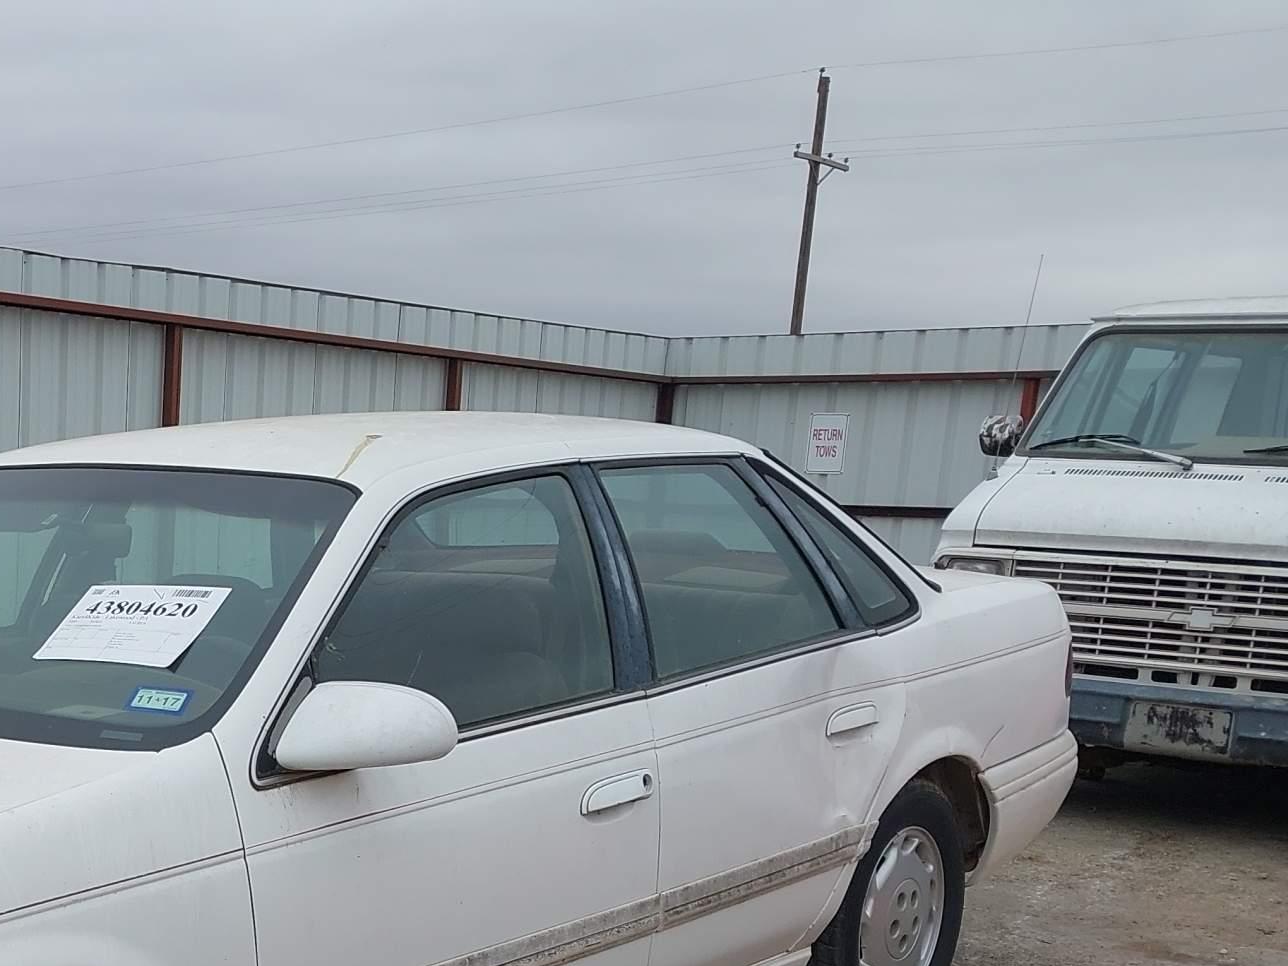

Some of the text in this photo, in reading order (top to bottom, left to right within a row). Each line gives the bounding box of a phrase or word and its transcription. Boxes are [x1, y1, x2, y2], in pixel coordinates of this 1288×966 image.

[813, 428, 843, 441] RETURN
[815, 445, 837, 458] TOWS
[85, 600, 198, 618] 43804620
